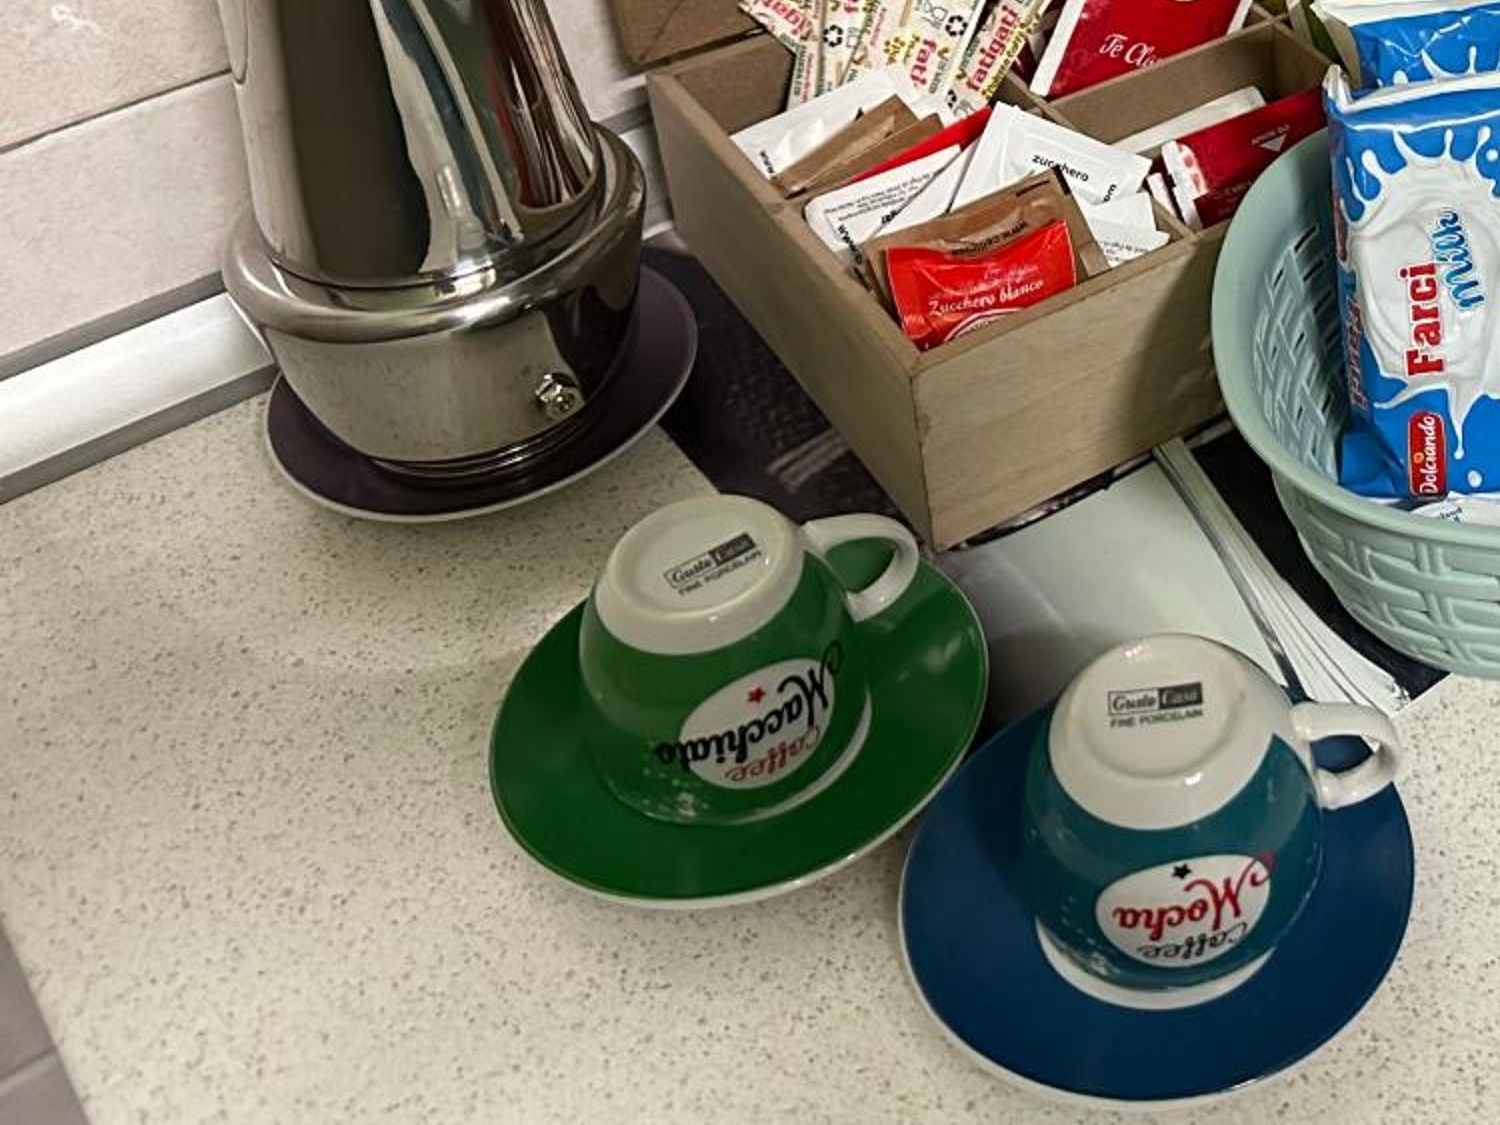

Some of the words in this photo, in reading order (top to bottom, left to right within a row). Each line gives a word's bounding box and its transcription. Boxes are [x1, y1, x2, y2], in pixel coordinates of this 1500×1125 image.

[928, 294, 995, 317] Zucchero
[1400, 262, 1444, 376] Farci
[1418, 412, 1441, 495] Dolciando
[654, 640, 844, 772] Macchiato
[1109, 716, 1136, 728] FINE
[1139, 707, 1203, 725] PORCELAIN
[1112, 693, 1157, 712] Gusto
[724, 724, 822, 782] Coffee
[1112, 850, 1278, 942] Mocha
[1136, 921, 1248, 961] Coffee
